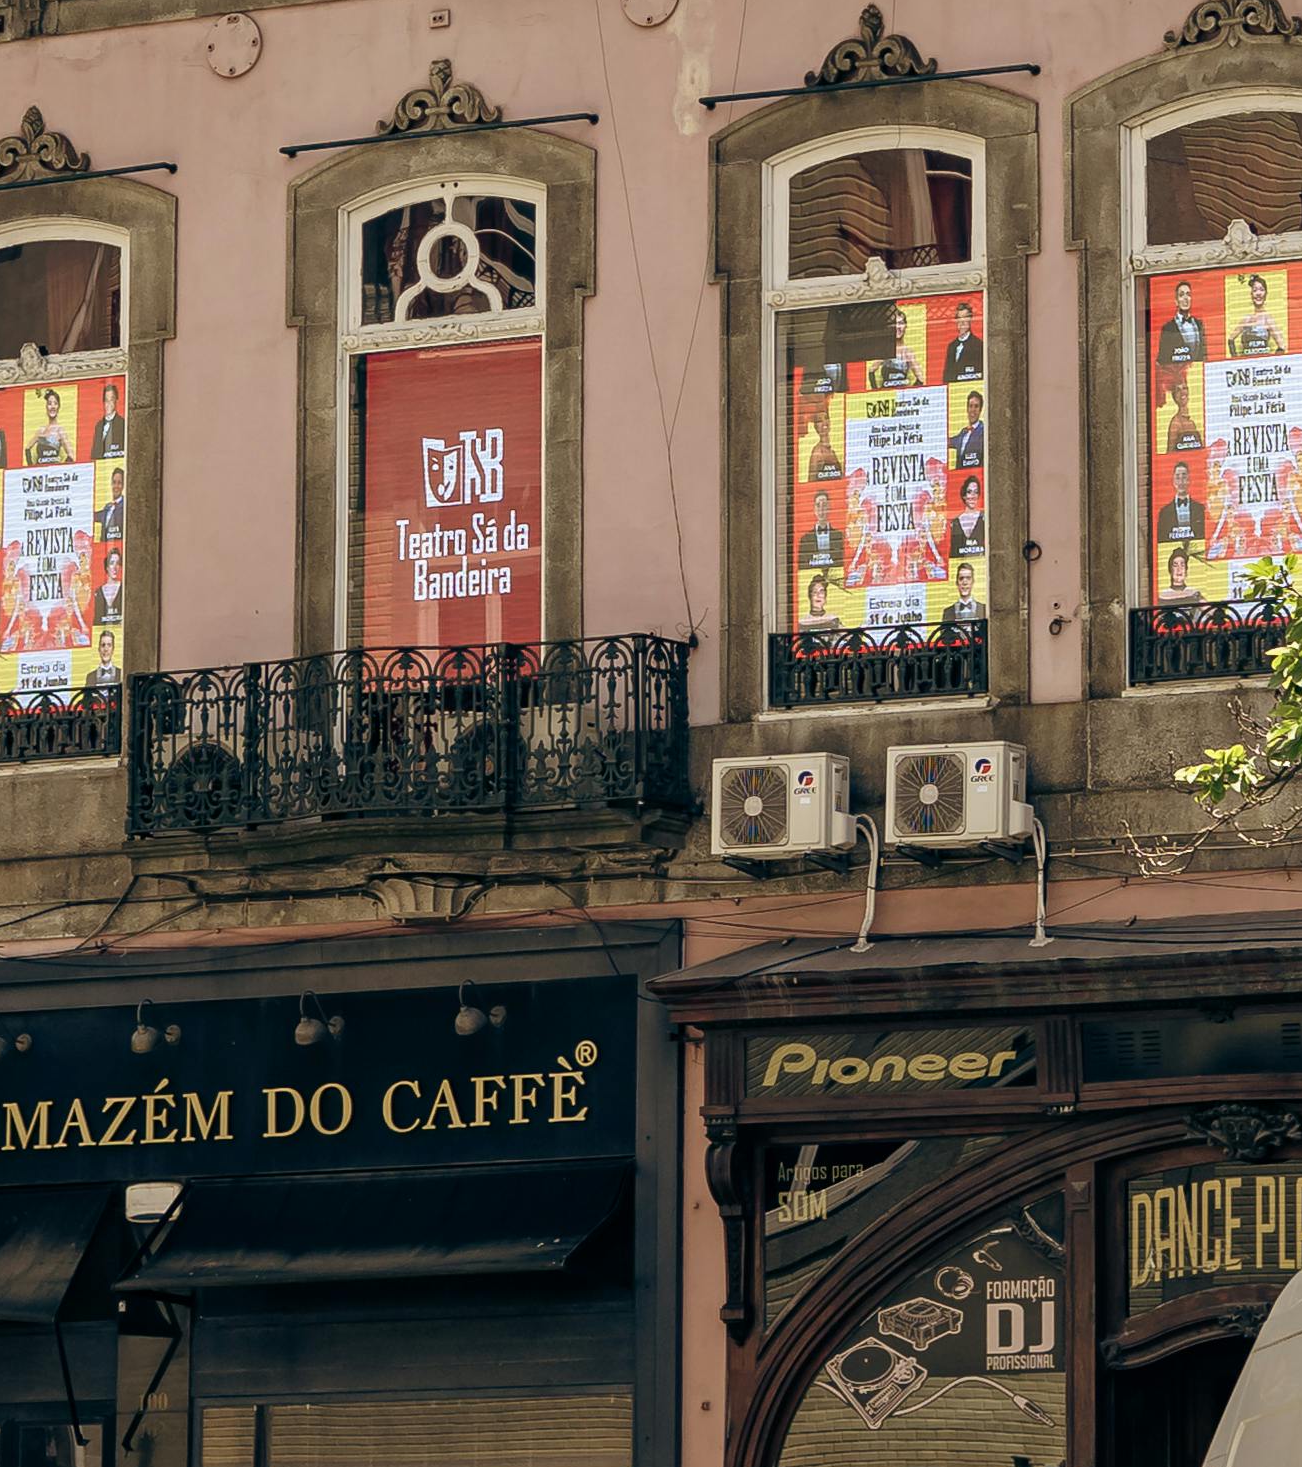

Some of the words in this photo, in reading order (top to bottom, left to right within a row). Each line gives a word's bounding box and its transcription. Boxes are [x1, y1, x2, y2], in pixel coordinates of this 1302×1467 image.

[1234, 424, 1289, 455] REVISTA
[873, 454, 926, 485] REVISTA
[1239, 474, 1279, 504] FESTA
[877, 502, 915, 532] FESTA
[27, 527, 74, 556] REVISTA
[396, 518, 466, 562] Teatro
[472, 512, 497, 555] Sá
[503, 510, 529, 552] da
[29, 573, 63, 601] FESTA
[414, 557, 511, 602] Bandeira
[883, 613, 893, 624] de
[762, 1042, 1017, 1086] Pioneer
[261, 1082, 352, 1138] DO
[778, 1162, 827, 1188] Artigos
[832, 1162, 864, 1182] para
[777, 1189, 828, 1224] SOM
[1131, 1177, 1242, 1290] DANCE
[986, 1276, 1055, 1303] FORMAÇÃO
[986, 1300, 1055, 1355] DJ
[986, 1352, 1055, 1371] PROFISSIONAL
